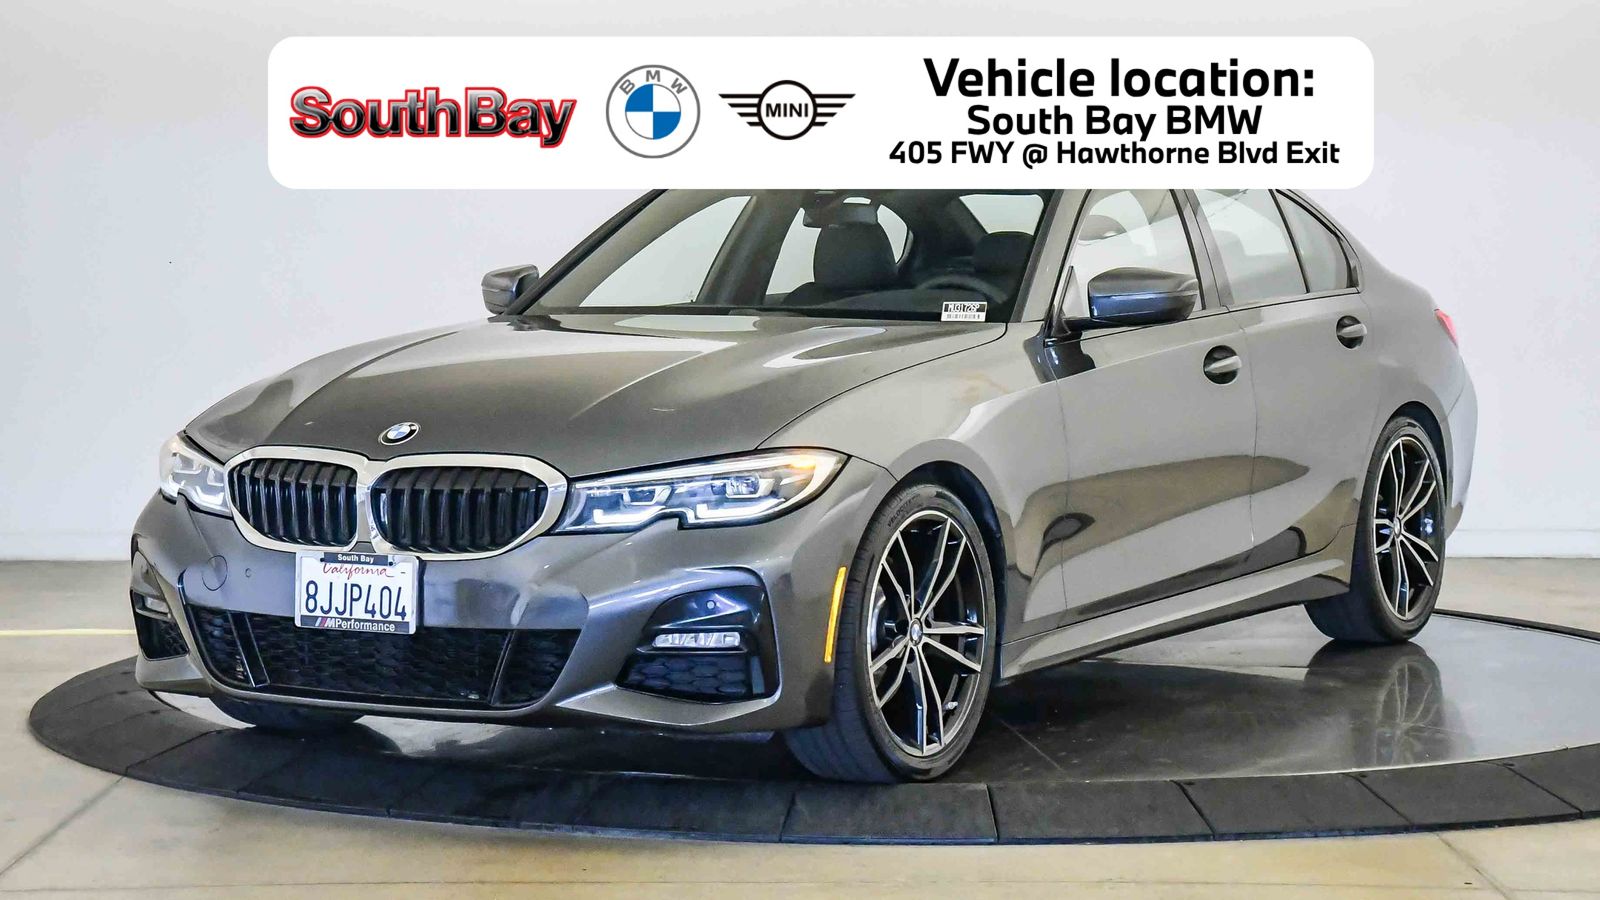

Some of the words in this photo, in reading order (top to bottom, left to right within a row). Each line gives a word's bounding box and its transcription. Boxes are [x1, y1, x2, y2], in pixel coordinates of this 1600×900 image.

[337, 554, 359, 562] South
[360, 556, 375, 564] Bay
[322, 563, 395, 580] California
[306, 580, 407, 620] 8JJP404
